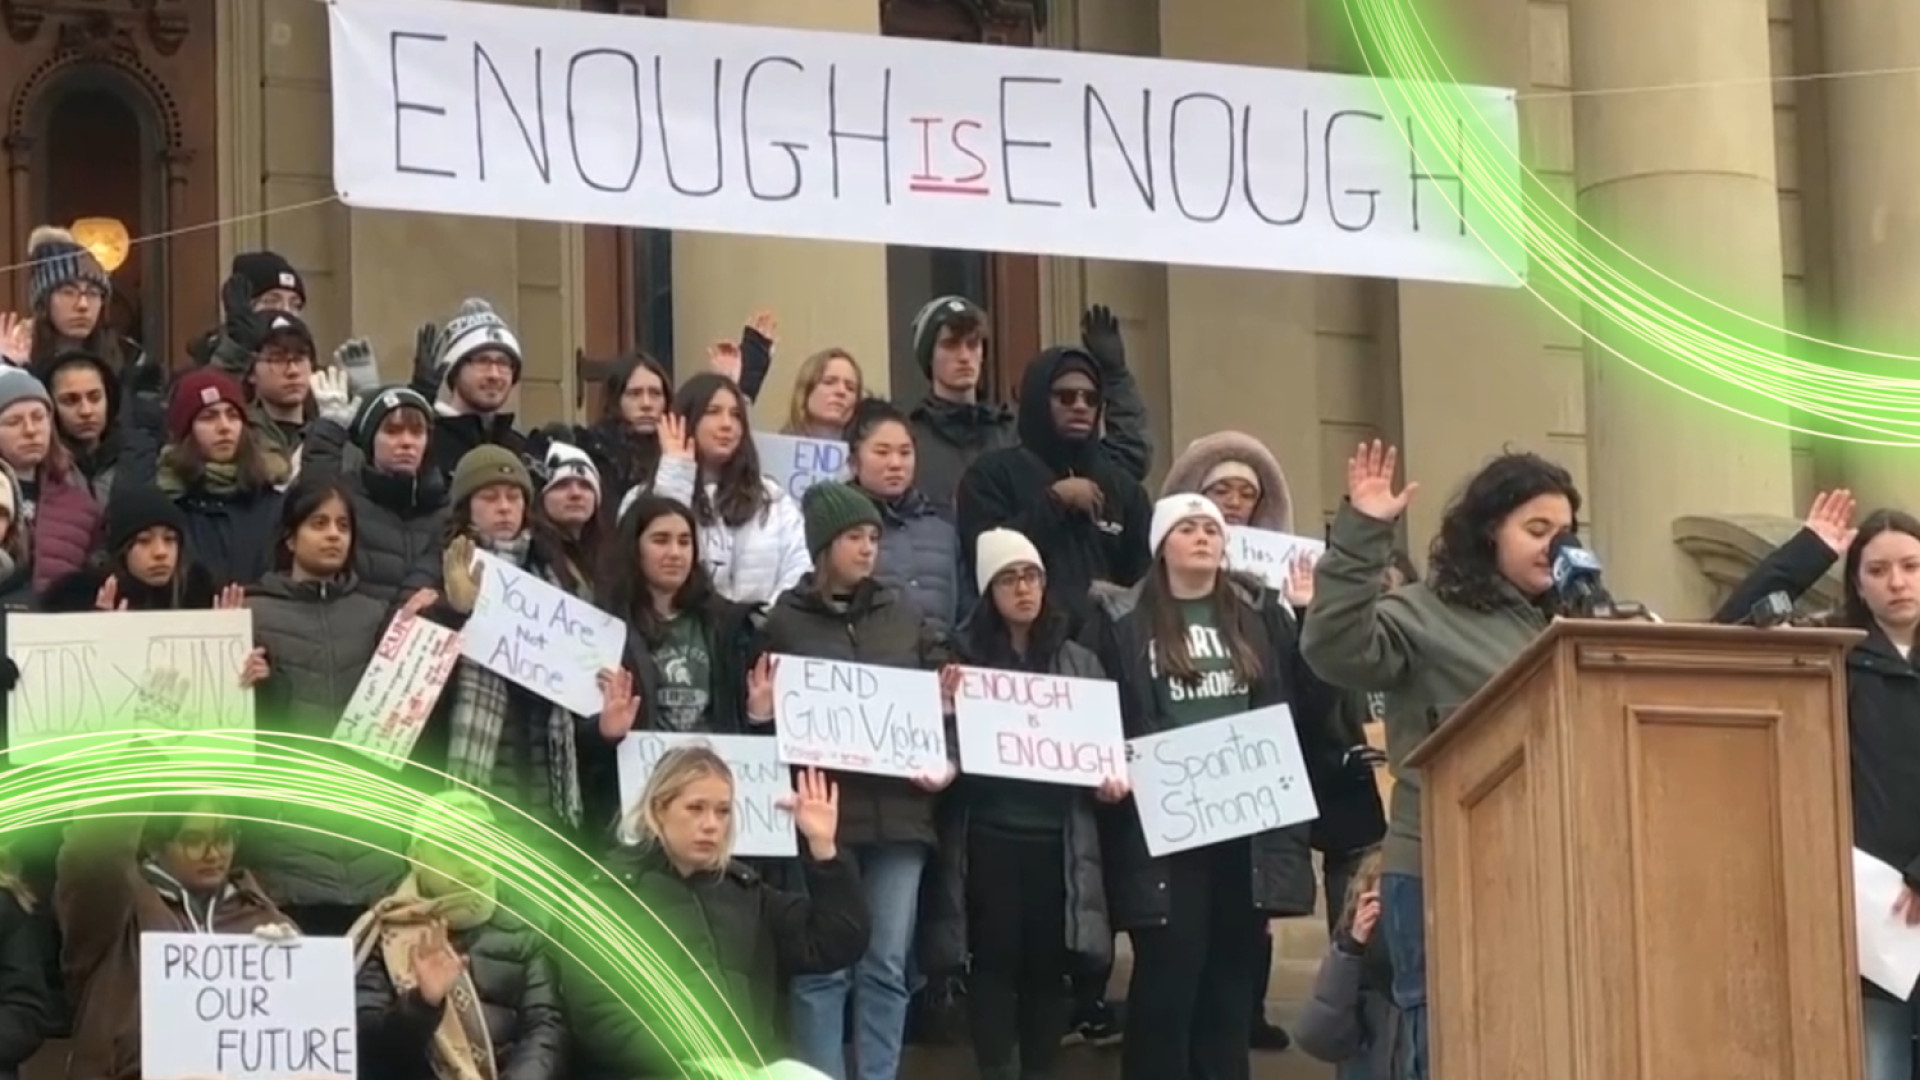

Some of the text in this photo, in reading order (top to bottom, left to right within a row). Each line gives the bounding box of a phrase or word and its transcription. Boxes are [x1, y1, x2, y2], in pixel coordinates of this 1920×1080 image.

[391, 31, 1467, 236] ENOUGH IS ENOUGH
[794, 440, 843, 474] END
[497, 568, 599, 648] You Are
[12, 645, 106, 734] KIDS
[488, 635, 565, 695] Alone
[804, 659, 879, 700] END
[960, 671, 1073, 710] ENOUGH
[782, 690, 855, 744] Gun
[996, 731, 1116, 775] ENOUGH
[1153, 723, 1281, 791] Spartan
[1160, 785, 1282, 843] Strong
[164, 943, 303, 982] PROTECT
[195, 985, 270, 1022] OUR
[216, 1027, 353, 1075] FUTURE
